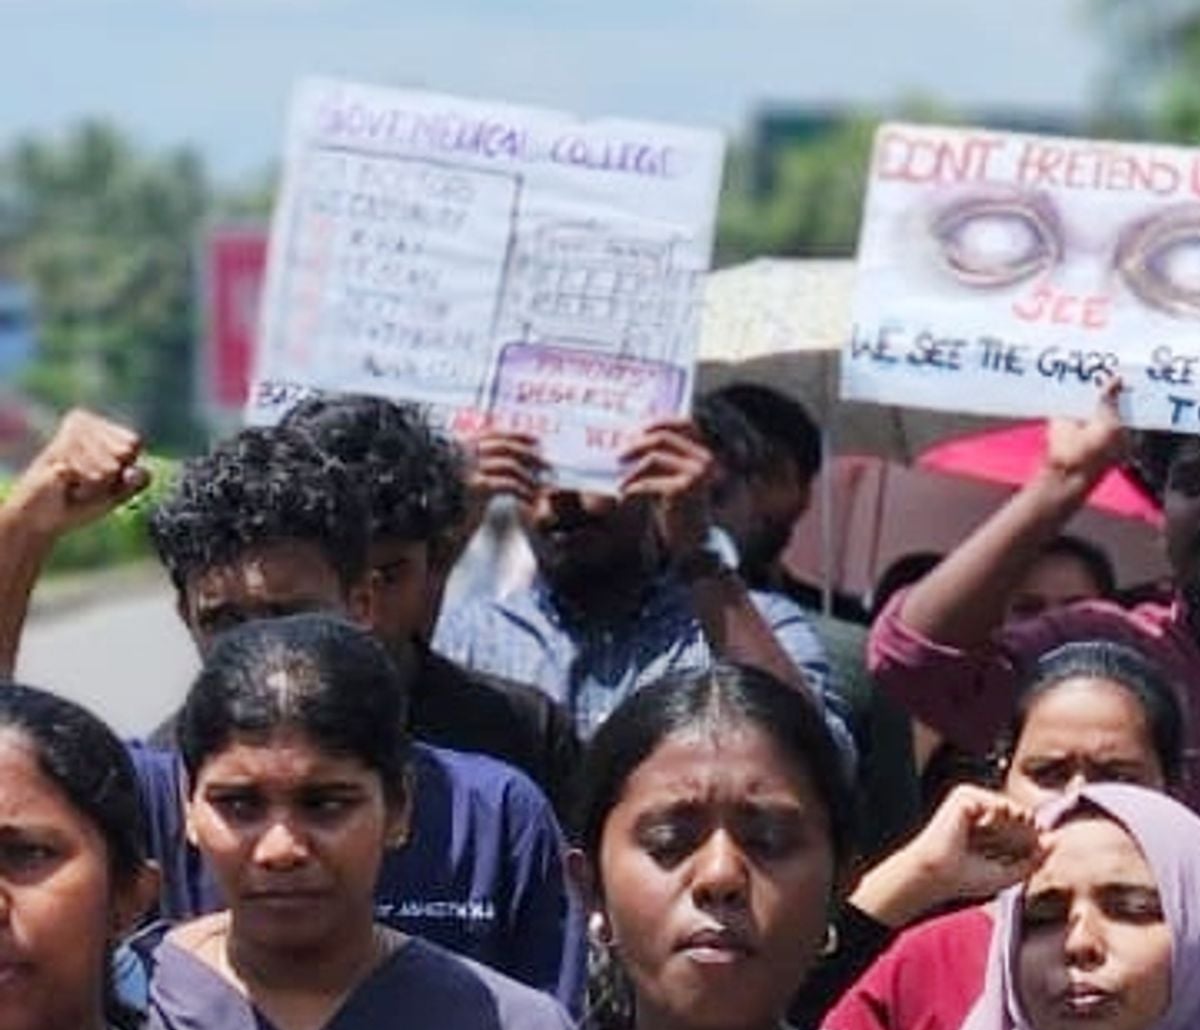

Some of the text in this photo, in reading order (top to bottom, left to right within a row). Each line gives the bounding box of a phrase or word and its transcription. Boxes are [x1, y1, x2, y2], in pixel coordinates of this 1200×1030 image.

[1017, 141, 1179, 196] PRETEND
[1012, 284, 1112, 328] SEE
[851, 325, 896, 364] WE
[905, 332, 967, 367] SEE
[977, 338, 1025, 376] THE
[1145, 346, 1199, 385] SEE
